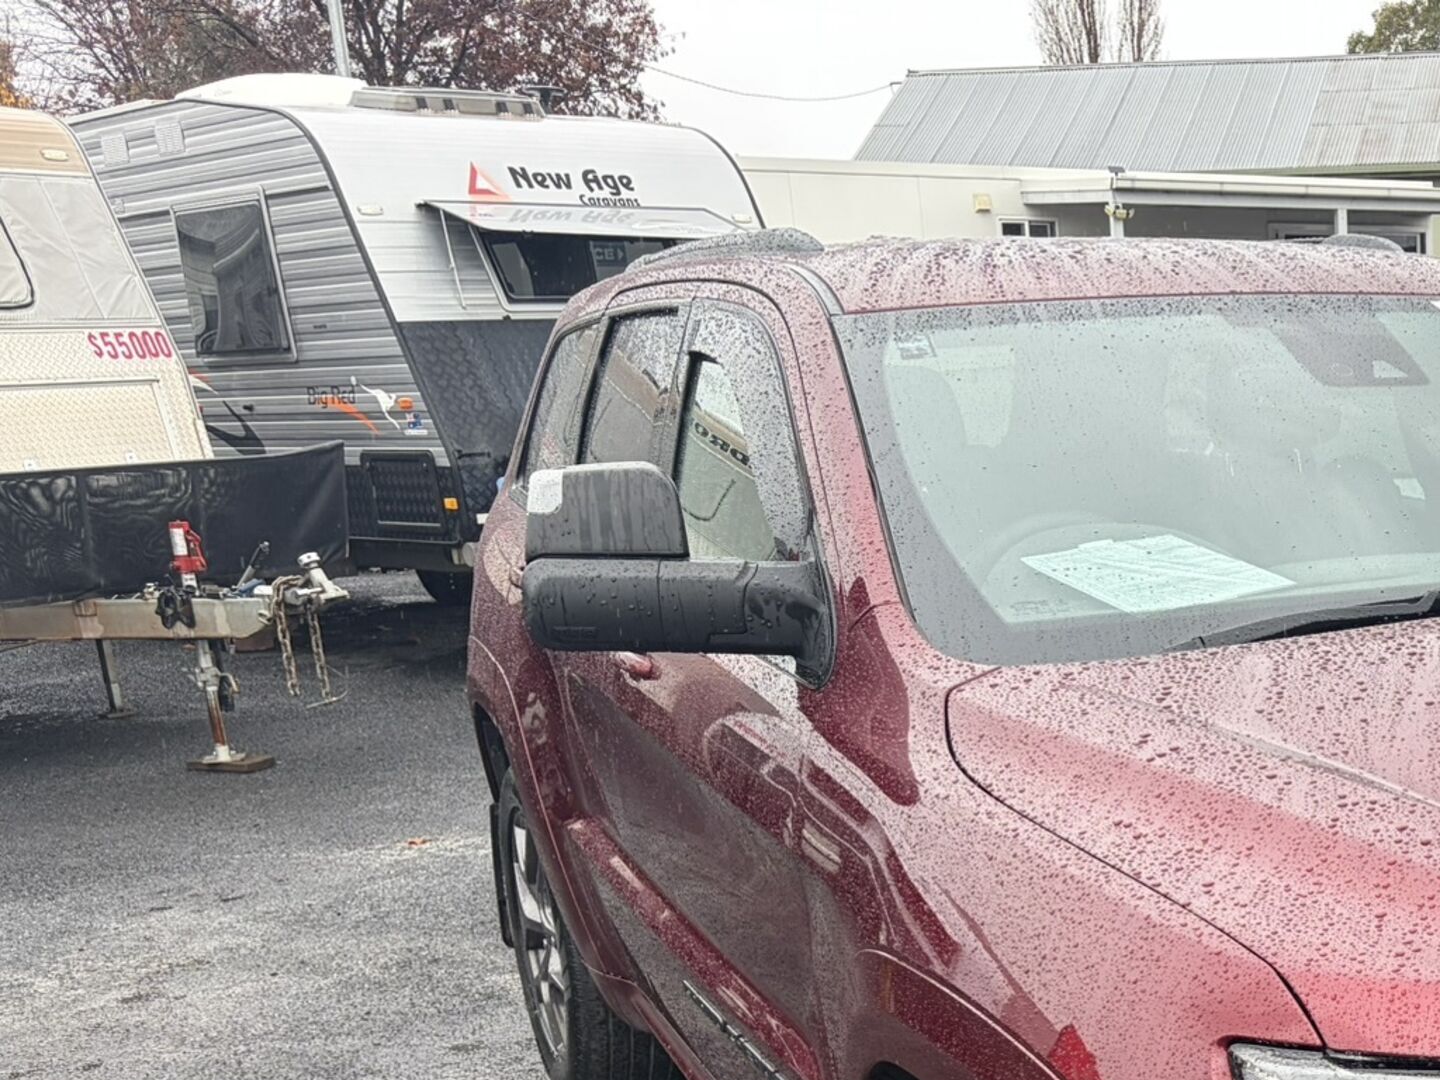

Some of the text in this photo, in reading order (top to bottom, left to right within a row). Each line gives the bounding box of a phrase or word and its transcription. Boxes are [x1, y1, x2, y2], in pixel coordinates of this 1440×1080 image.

[507, 166, 635, 196] New Age
[578, 194, 641, 207] Caravans
[87, 331, 172, 359] $55000
[307, 384, 356, 408] Big Red
